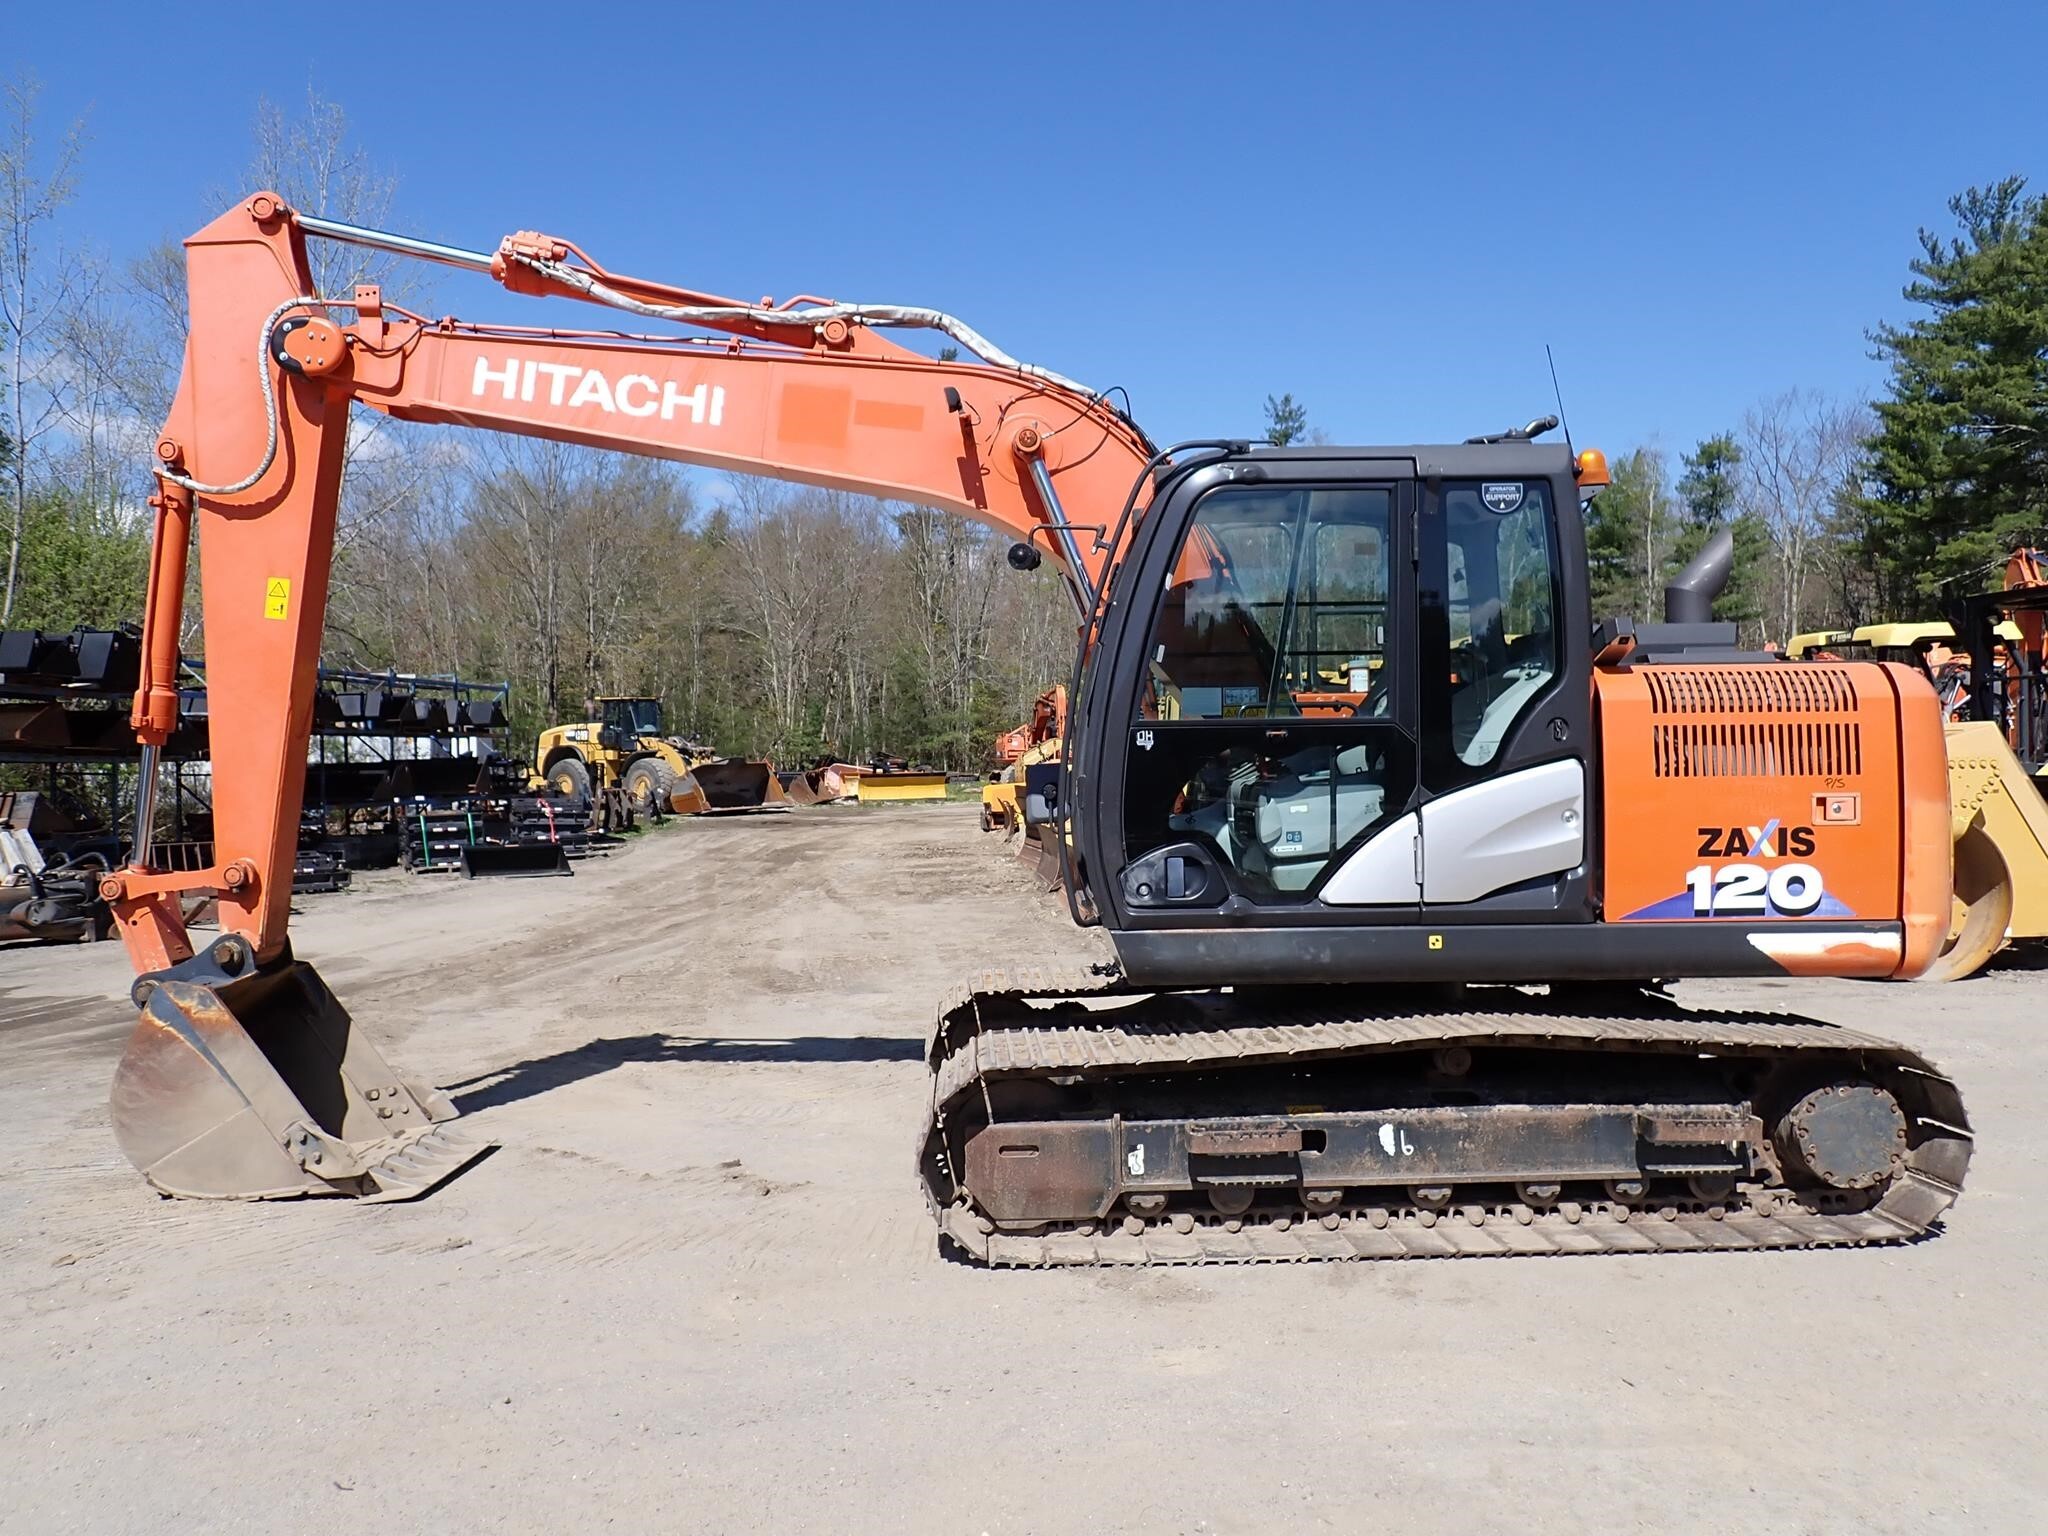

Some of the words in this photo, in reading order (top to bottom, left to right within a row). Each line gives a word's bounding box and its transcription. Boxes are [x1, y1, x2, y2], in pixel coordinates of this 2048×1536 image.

[472, 356, 725, 426] HITACHI
[1485, 493, 1520, 501] SUPPORT
[1824, 777, 1846, 789] P/S
[1698, 819, 1816, 857] ZAXIS
[1686, 864, 1823, 917] 120
